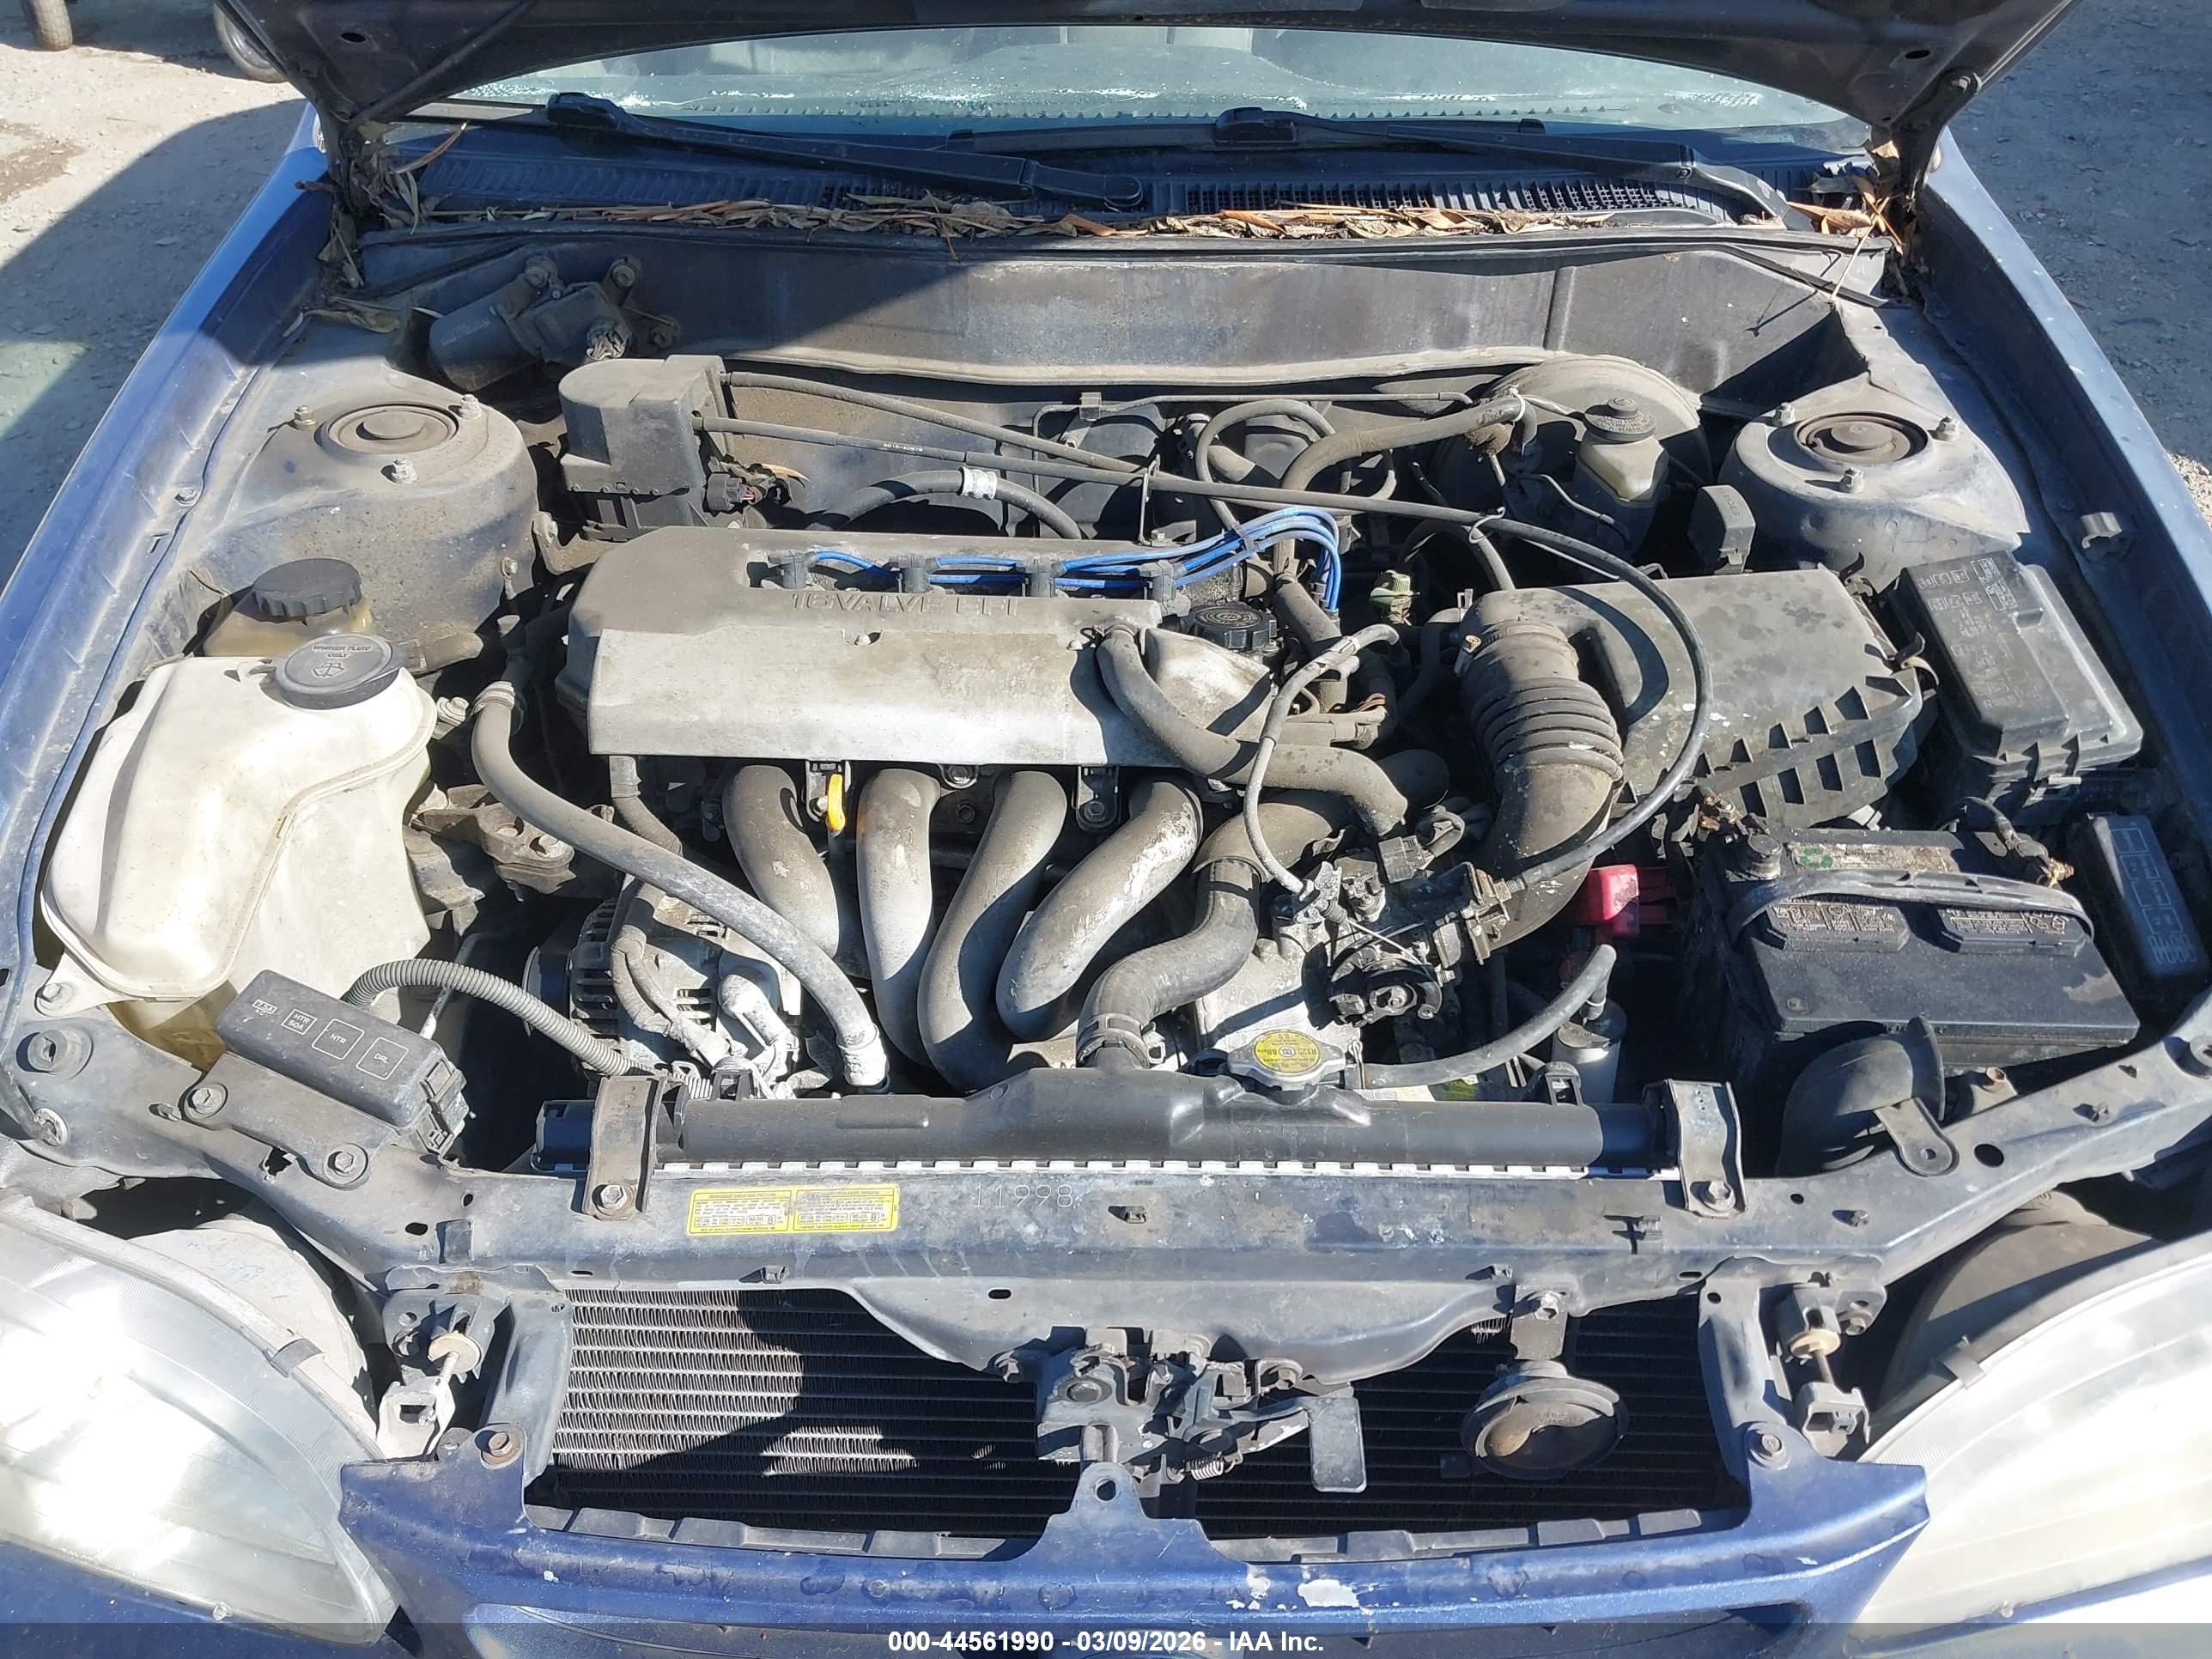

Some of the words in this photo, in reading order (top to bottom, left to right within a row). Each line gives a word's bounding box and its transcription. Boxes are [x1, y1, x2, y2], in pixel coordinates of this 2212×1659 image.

[293, 1013, 311, 1024] HTR
[330, 1033, 347, 1044] HTR
[374, 1053, 389, 1064] DRL
[975, 1183, 1073, 1208] 11998
